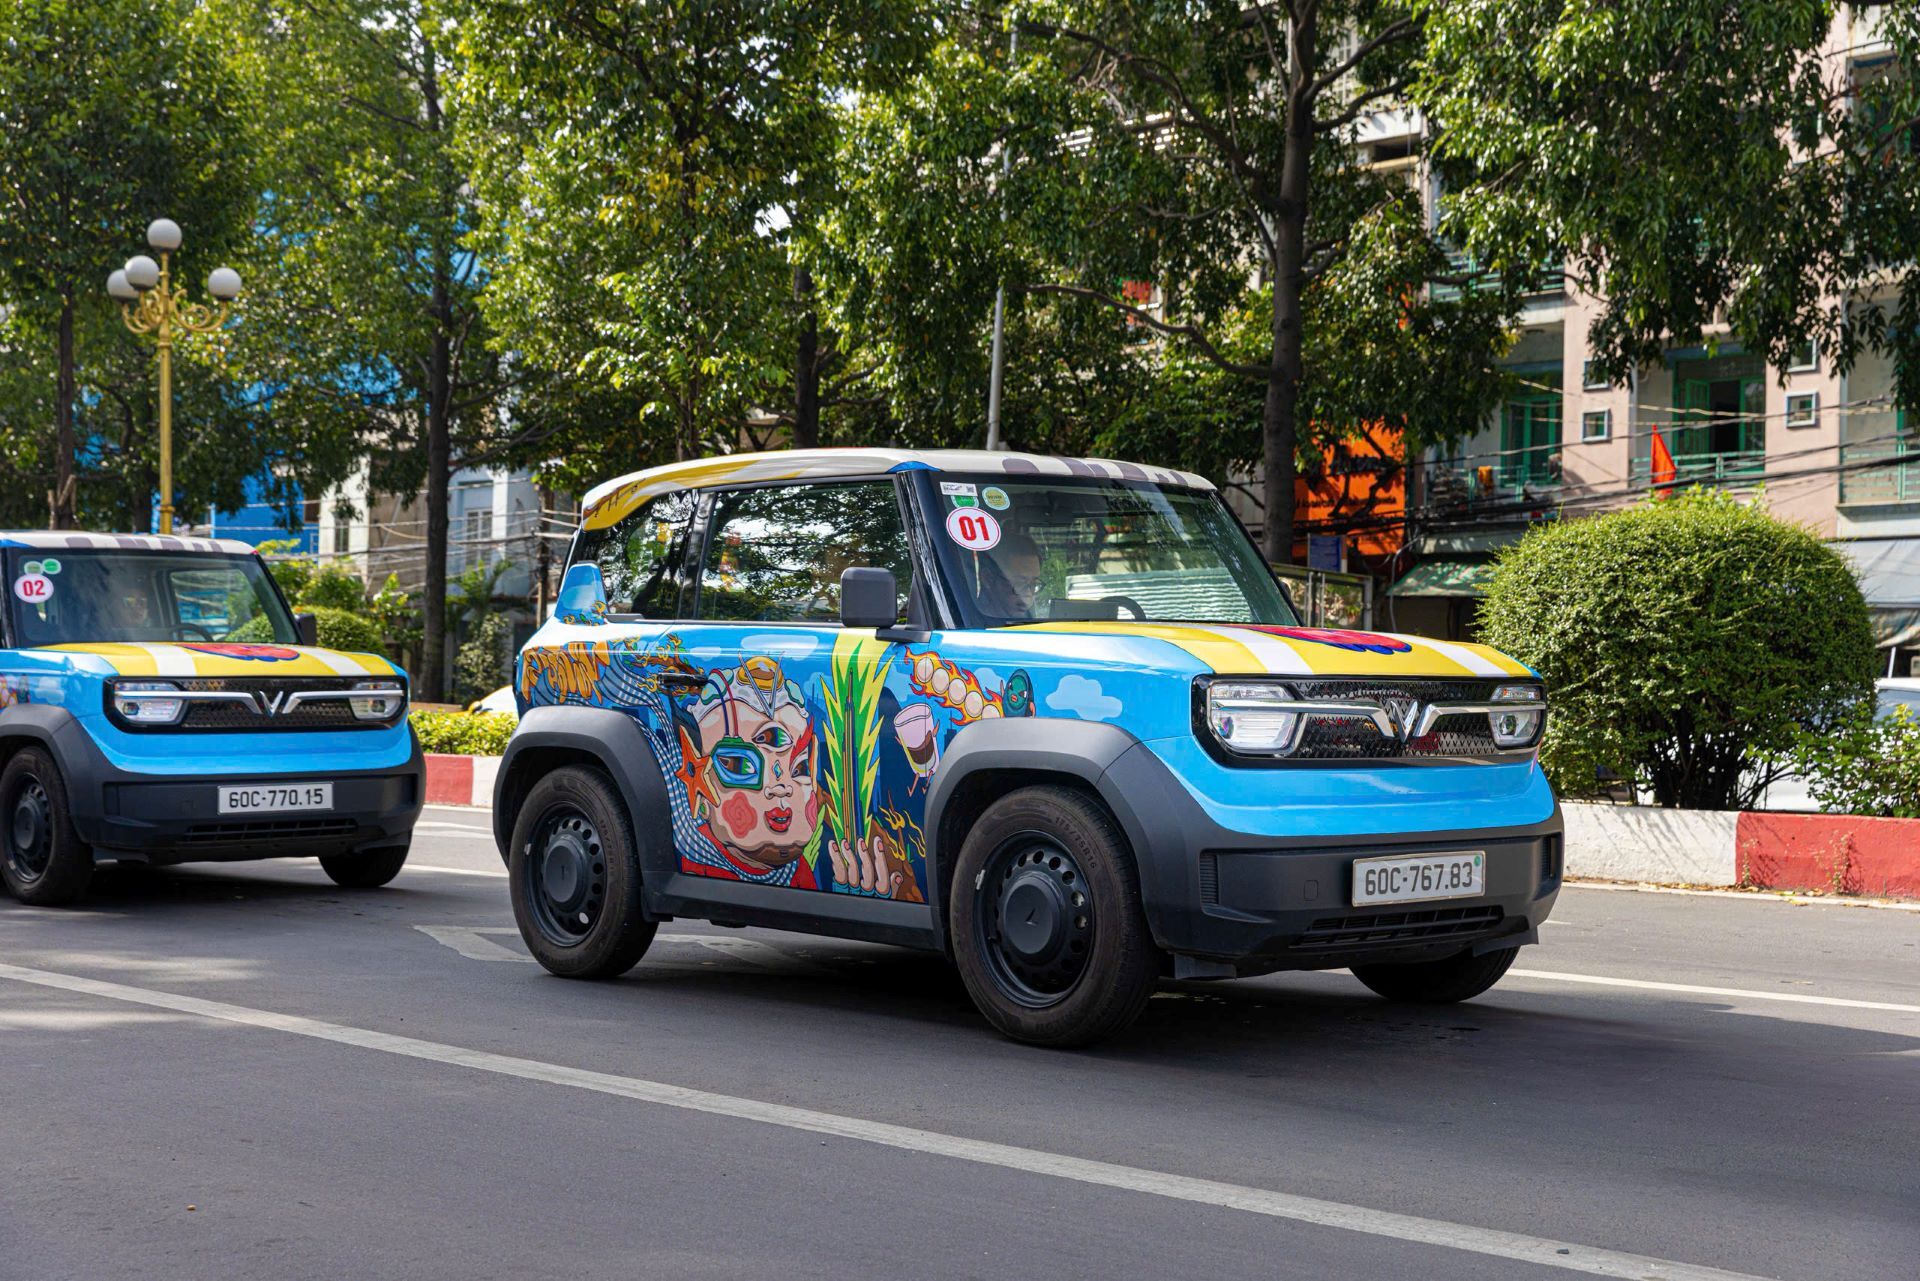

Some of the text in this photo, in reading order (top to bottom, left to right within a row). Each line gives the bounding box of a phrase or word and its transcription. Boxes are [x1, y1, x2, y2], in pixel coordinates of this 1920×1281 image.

[958, 515, 990, 542] 01
[22, 580, 46, 597] 02
[229, 788, 324, 808] 60C-770.15
[1365, 861, 1473, 896] 60C-767.83
